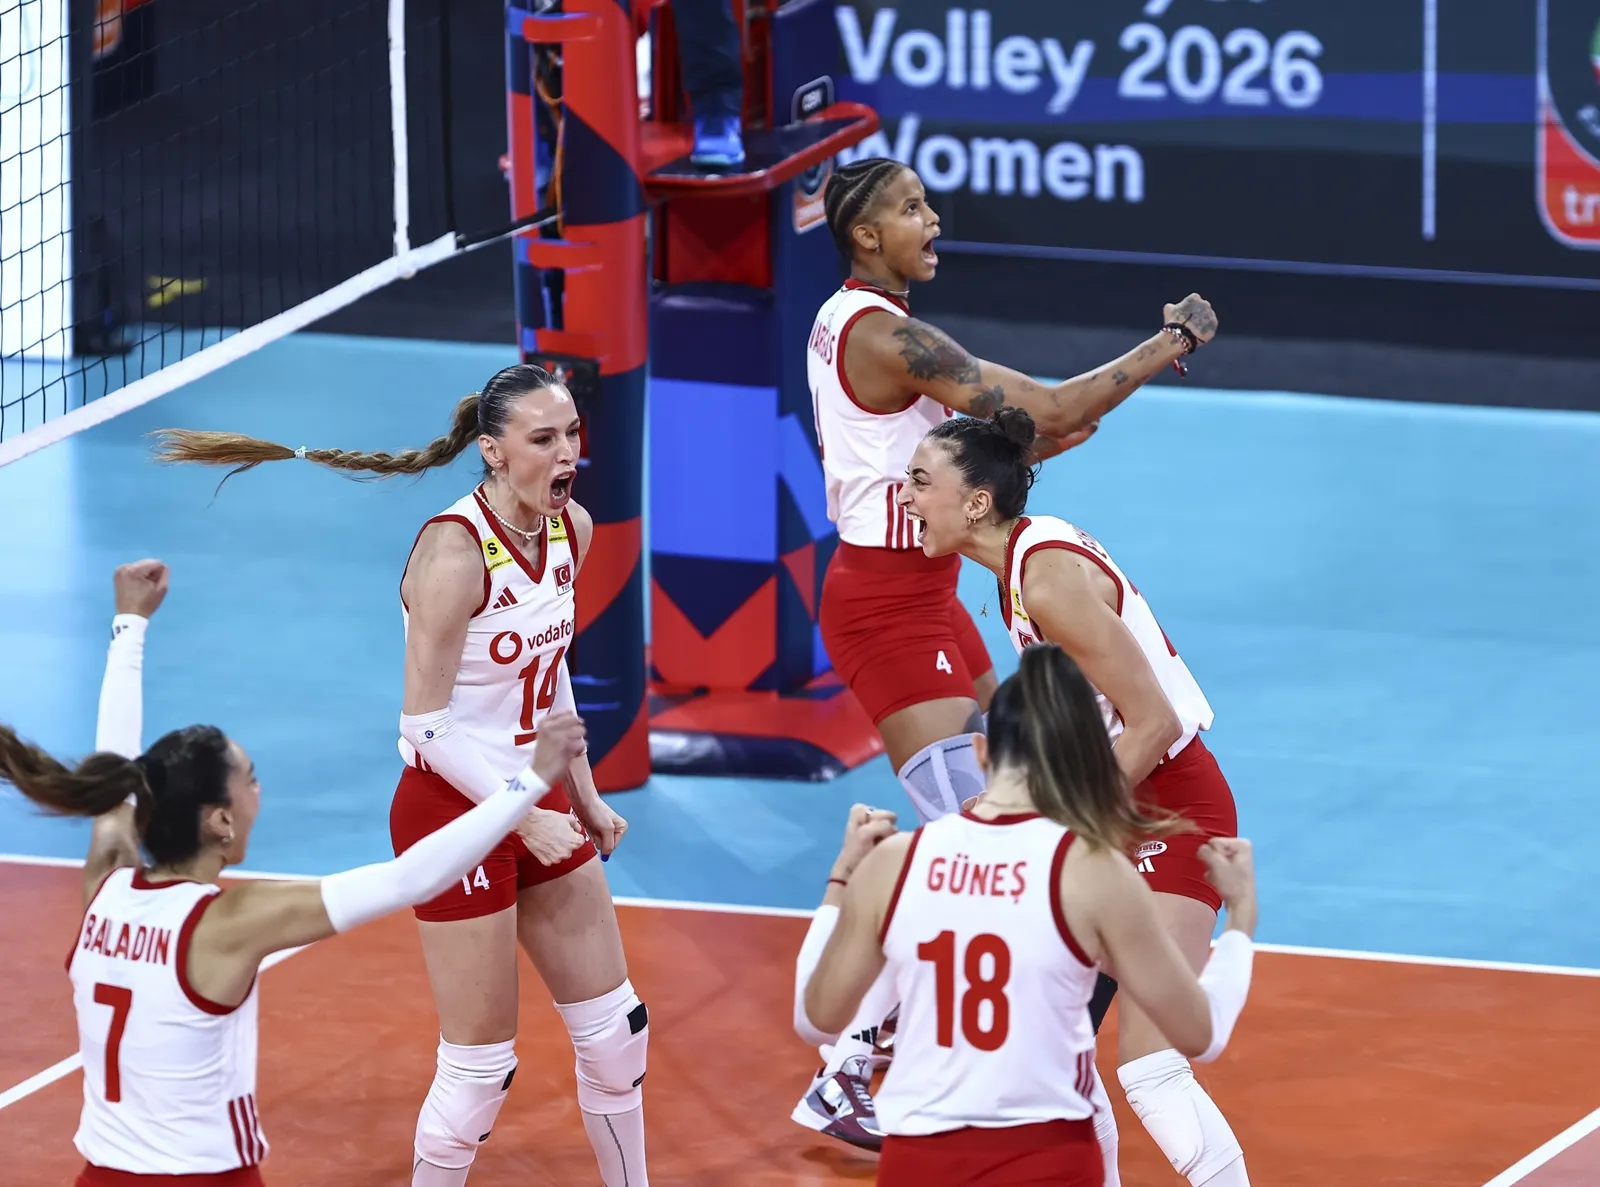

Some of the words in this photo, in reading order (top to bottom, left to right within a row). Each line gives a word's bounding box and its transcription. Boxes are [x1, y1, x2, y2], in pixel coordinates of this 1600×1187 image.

[836, 7, 1095, 114] Volley
[1118, 22, 1324, 108] 2026
[487, 542, 498, 556] S
[518, 645, 565, 731] 14
[936, 650, 953, 675] 4
[460, 865, 490, 896] 14
[927, 853, 1027, 904] GÜNEŞ
[83, 913, 172, 966] BALADIN
[917, 929, 1011, 1052] 18
[94, 982, 132, 1103] 7
